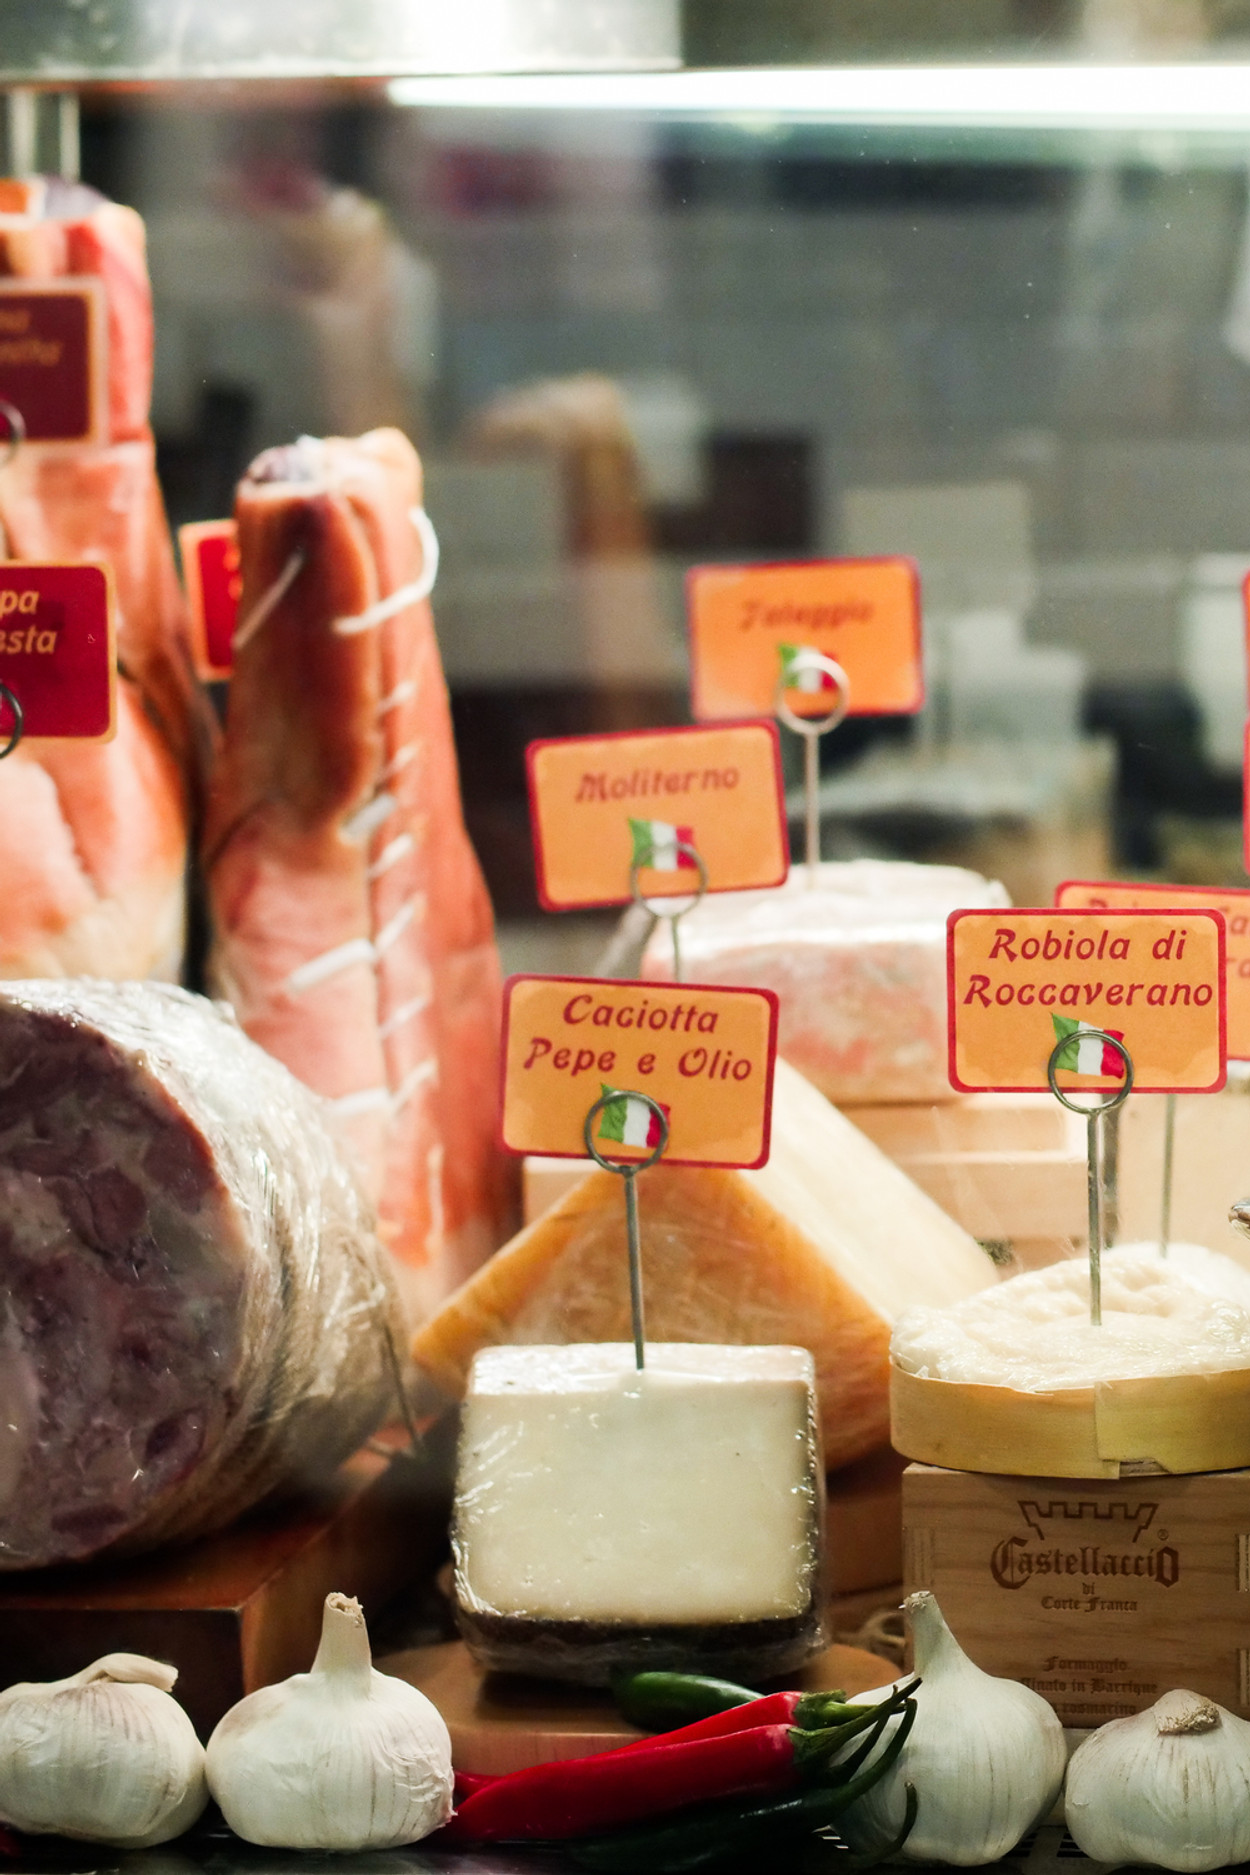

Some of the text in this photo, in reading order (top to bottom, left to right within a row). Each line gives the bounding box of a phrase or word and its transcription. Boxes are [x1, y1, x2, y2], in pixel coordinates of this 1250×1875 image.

[575, 763, 739, 804] Moliterno
[988, 928, 1187, 963] Robiola di
[963, 974, 1213, 1009] Roccaverano
[562, 994, 719, 1034] Caciotta
[523, 1037, 753, 1081] Pepe e Olio
[1041, 1596, 1139, 1613] Corte Franca
[1082, 1582, 1096, 1595] di
